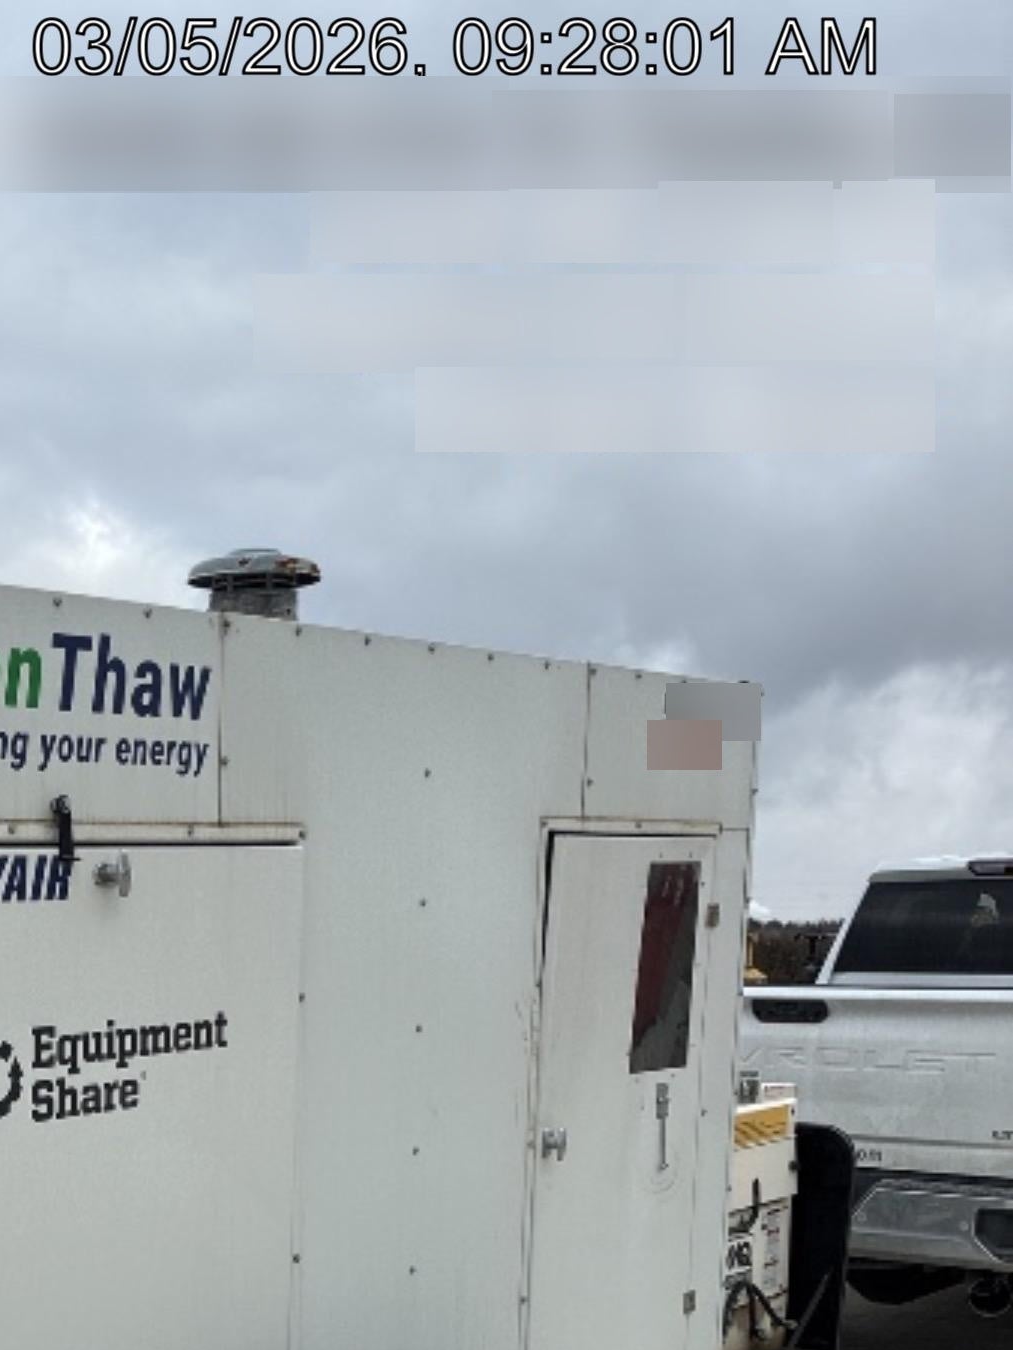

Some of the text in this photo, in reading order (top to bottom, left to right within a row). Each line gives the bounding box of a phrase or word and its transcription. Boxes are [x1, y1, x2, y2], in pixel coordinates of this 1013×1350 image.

[37, 733, 107, 772] your
[115, 736, 209, 778] energy
[32, 1011, 227, 1075] Equipment
[32, 1077, 140, 1123] Share
